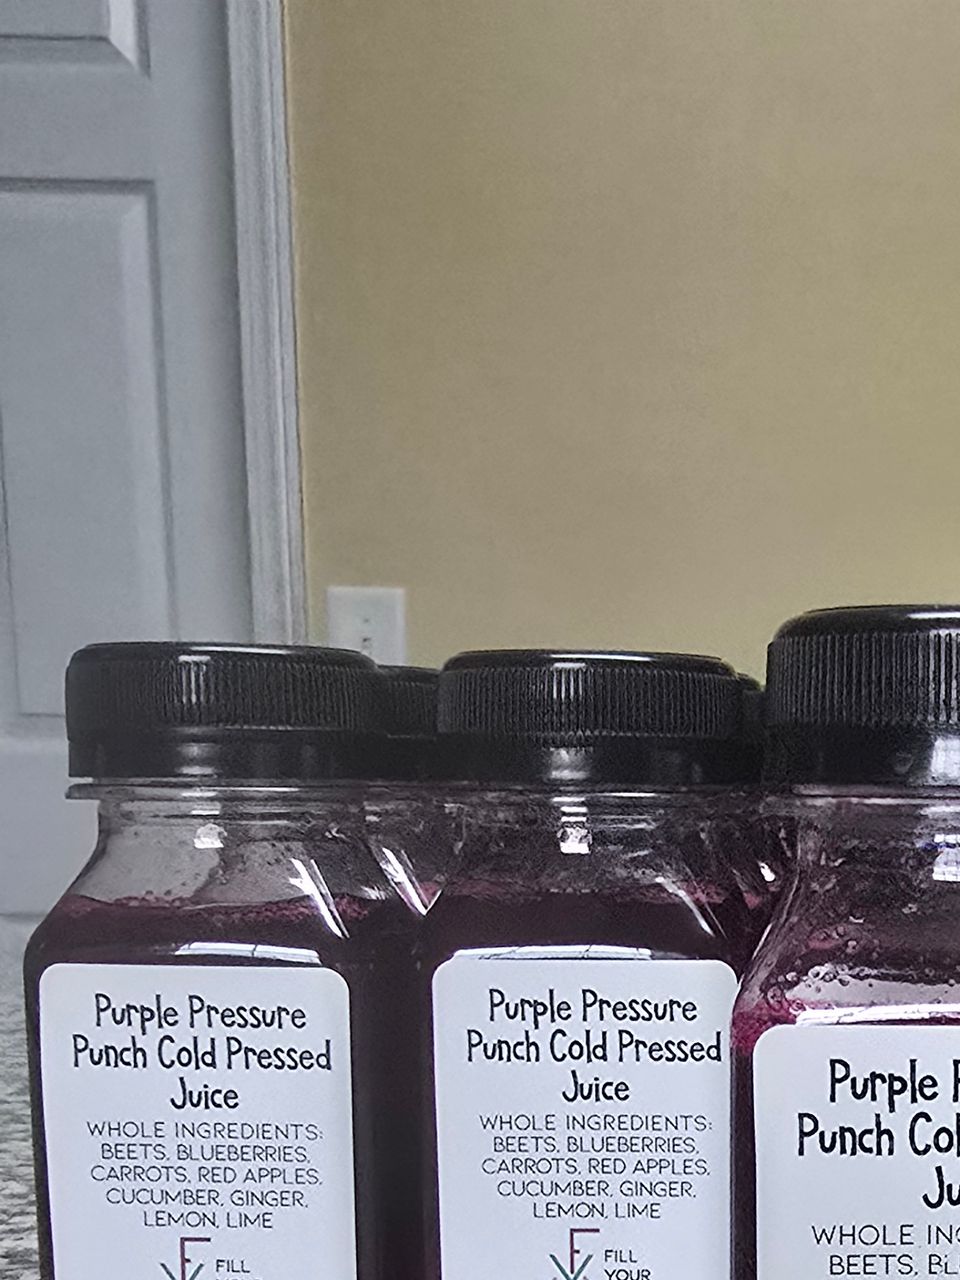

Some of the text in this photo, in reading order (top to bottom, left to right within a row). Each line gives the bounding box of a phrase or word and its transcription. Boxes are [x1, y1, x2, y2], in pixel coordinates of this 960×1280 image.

[95, 993, 306, 1036] Purple Pressure
[489, 988, 697, 1030] Purple Pressure
[72, 1034, 332, 1071] Punch Cold Pressed
[467, 1028, 722, 1064] Punch Cold Pressed
[170, 1077, 239, 1110] Juice
[562, 1069, 629, 1102] Juice
[829, 1059, 939, 1113] Purple
[87, 1121, 323, 1141] WHOLE INGREDIENTS:
[479, 1114, 712, 1132] WHOLE INGREDIENTS:
[798, 1113, 894, 1156] Punch
[198, 1166, 237, 1184] RED
[588, 1158, 626, 1174] RED
[226, 1212, 273, 1228] LIME
[615, 1202, 661, 1219] LIME
[811, 1224, 914, 1246] WHOLE
[216, 1259, 250, 1273] FILL
[605, 1249, 638, 1263] FILL
[830, 1254, 918, 1276] BEETS,
